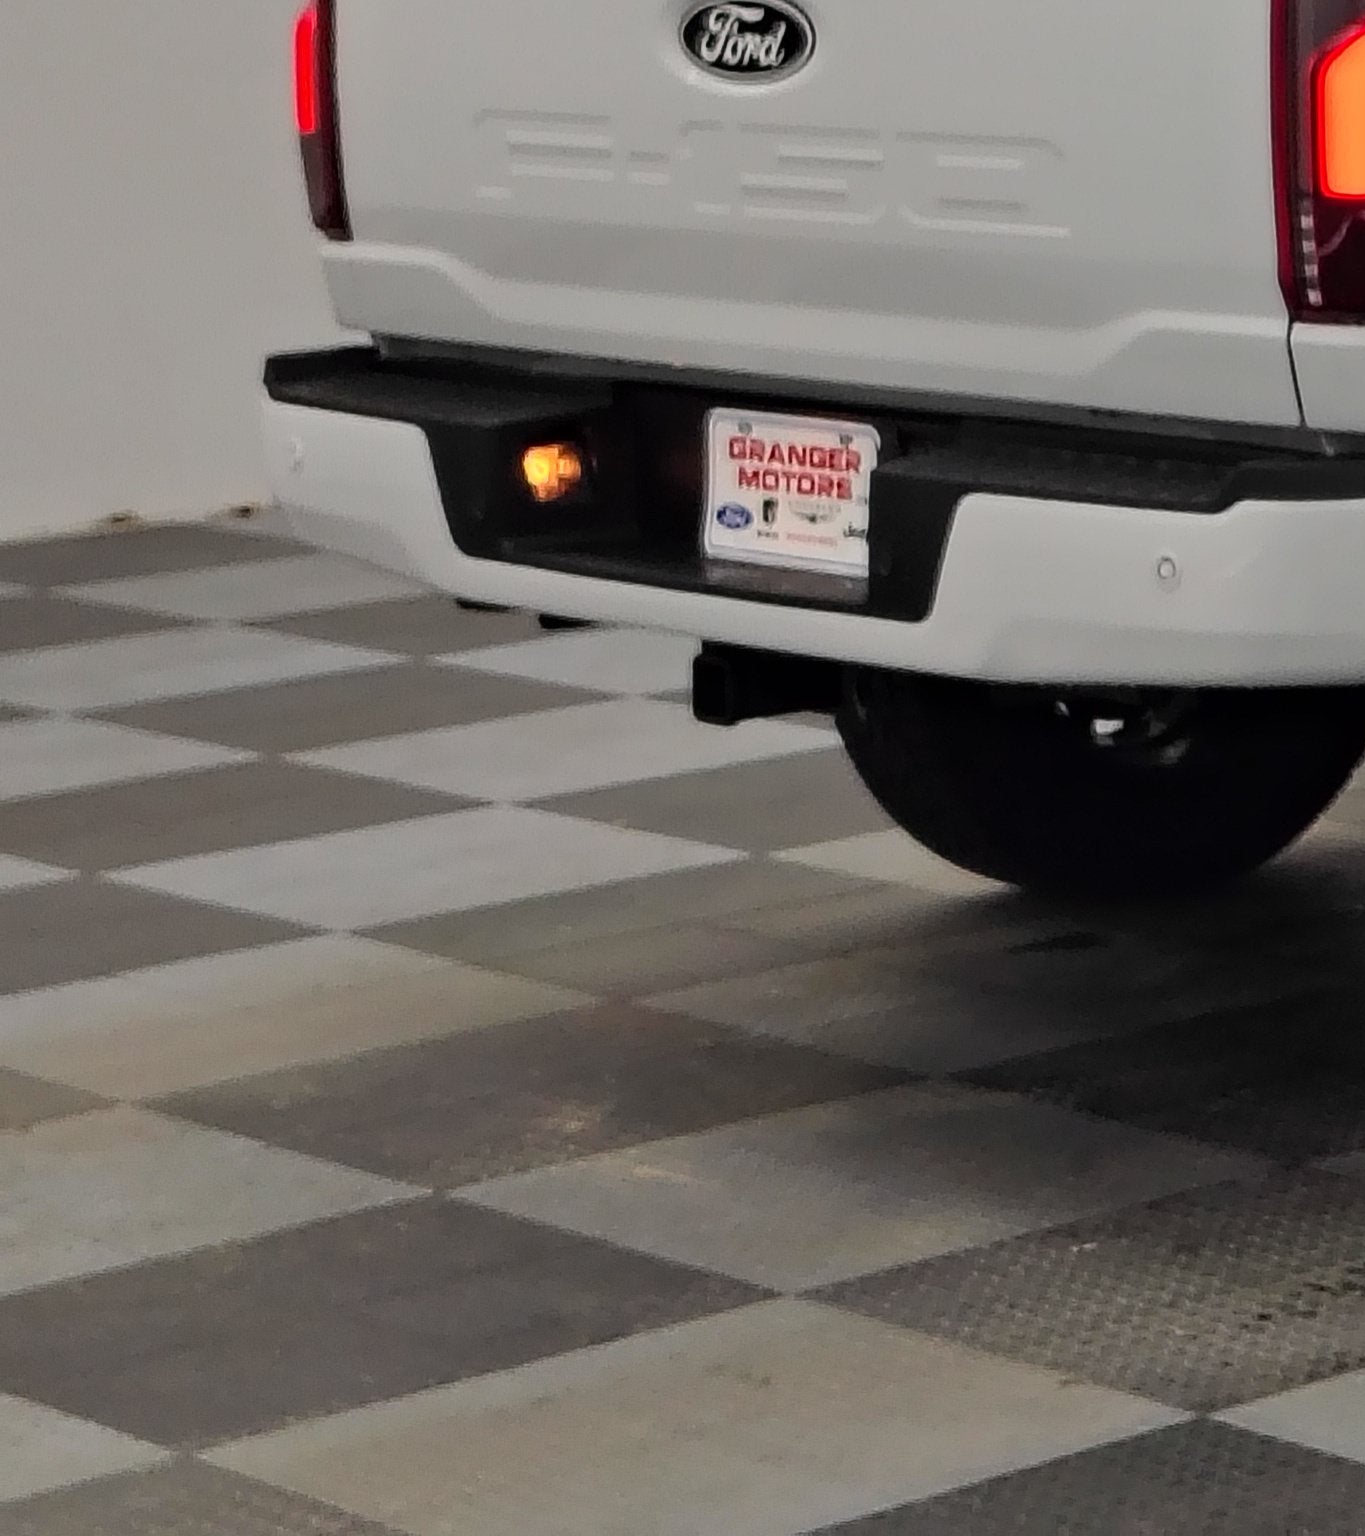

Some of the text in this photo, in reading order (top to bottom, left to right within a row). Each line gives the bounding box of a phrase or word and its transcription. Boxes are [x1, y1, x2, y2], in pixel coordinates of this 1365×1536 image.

[700, 2, 786, 67] Ford
[473, 107, 1074, 238] F-150
[728, 436, 861, 474] GRANGER
[738, 466, 853, 500] MOTORS
